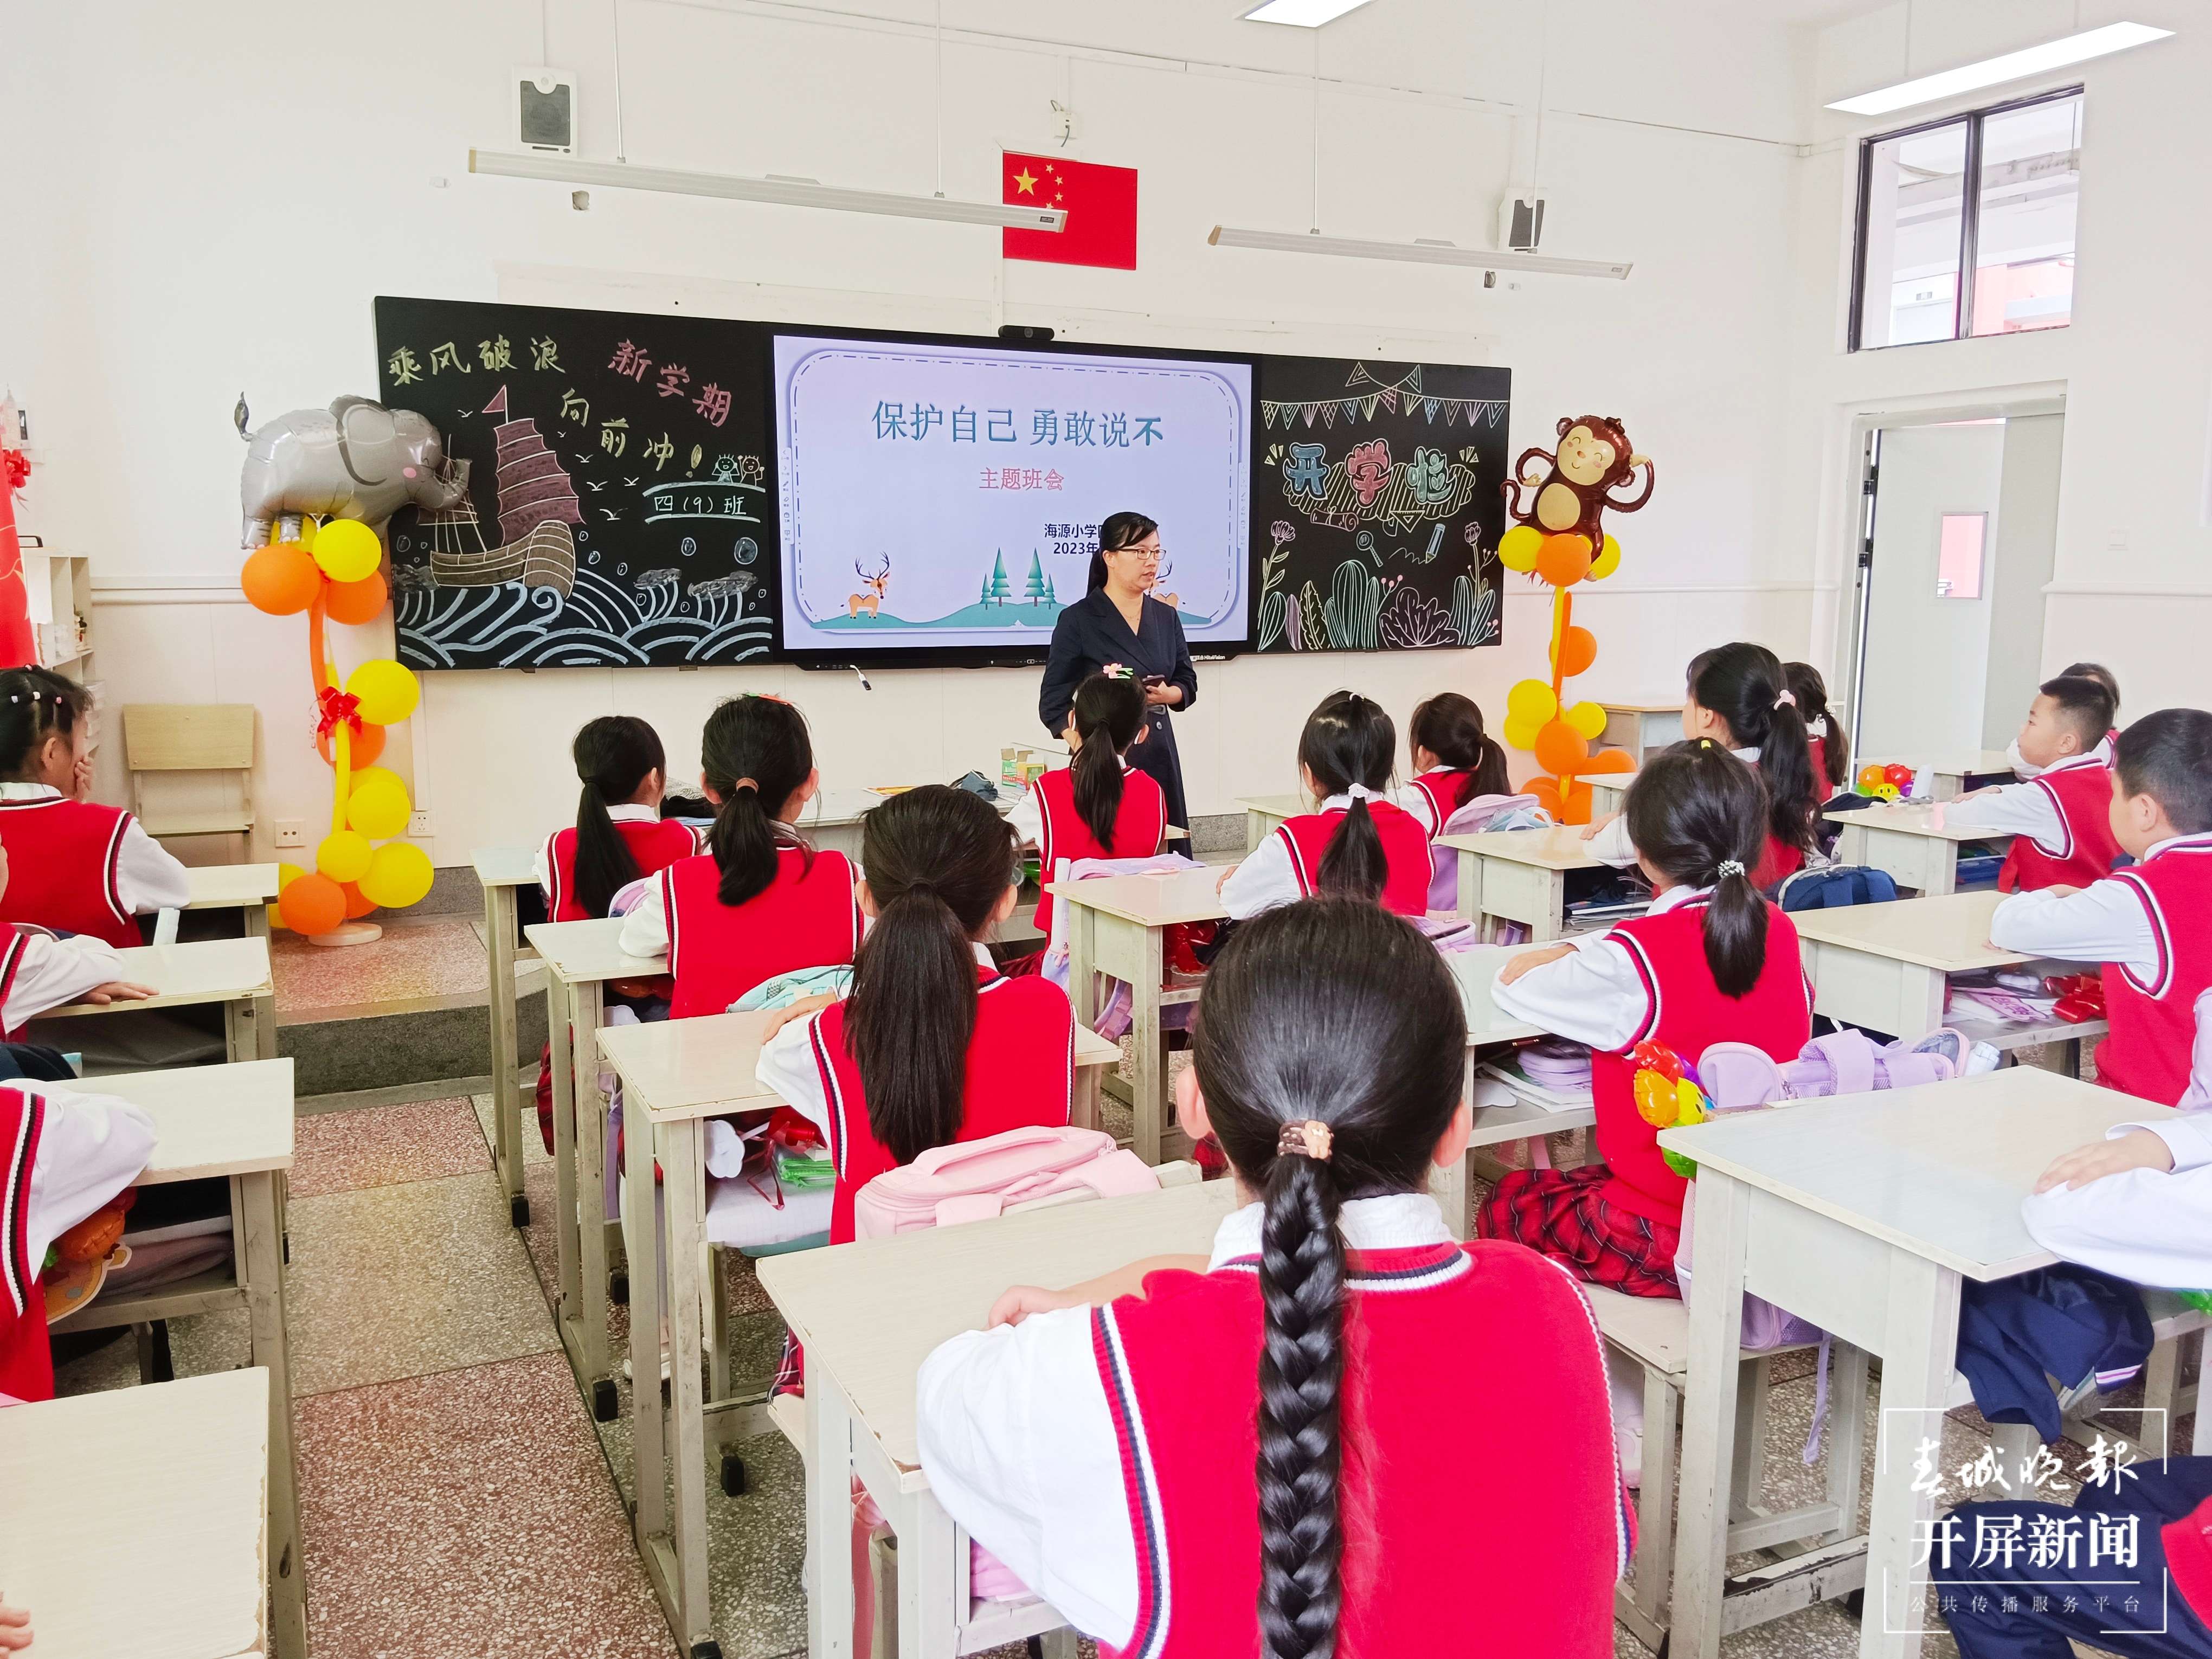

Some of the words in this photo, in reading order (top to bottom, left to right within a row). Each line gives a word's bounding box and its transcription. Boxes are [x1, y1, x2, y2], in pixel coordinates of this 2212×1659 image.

[388, 335, 565, 386] 乘风破浪
[608, 338, 731, 427] 新学期
[872, 400, 1017, 443] 保护自己
[1030, 409, 1163, 448] 勇敢说不
[979, 467, 1064, 491] 主题班会
[1283, 439, 1457, 508] 开学啦
